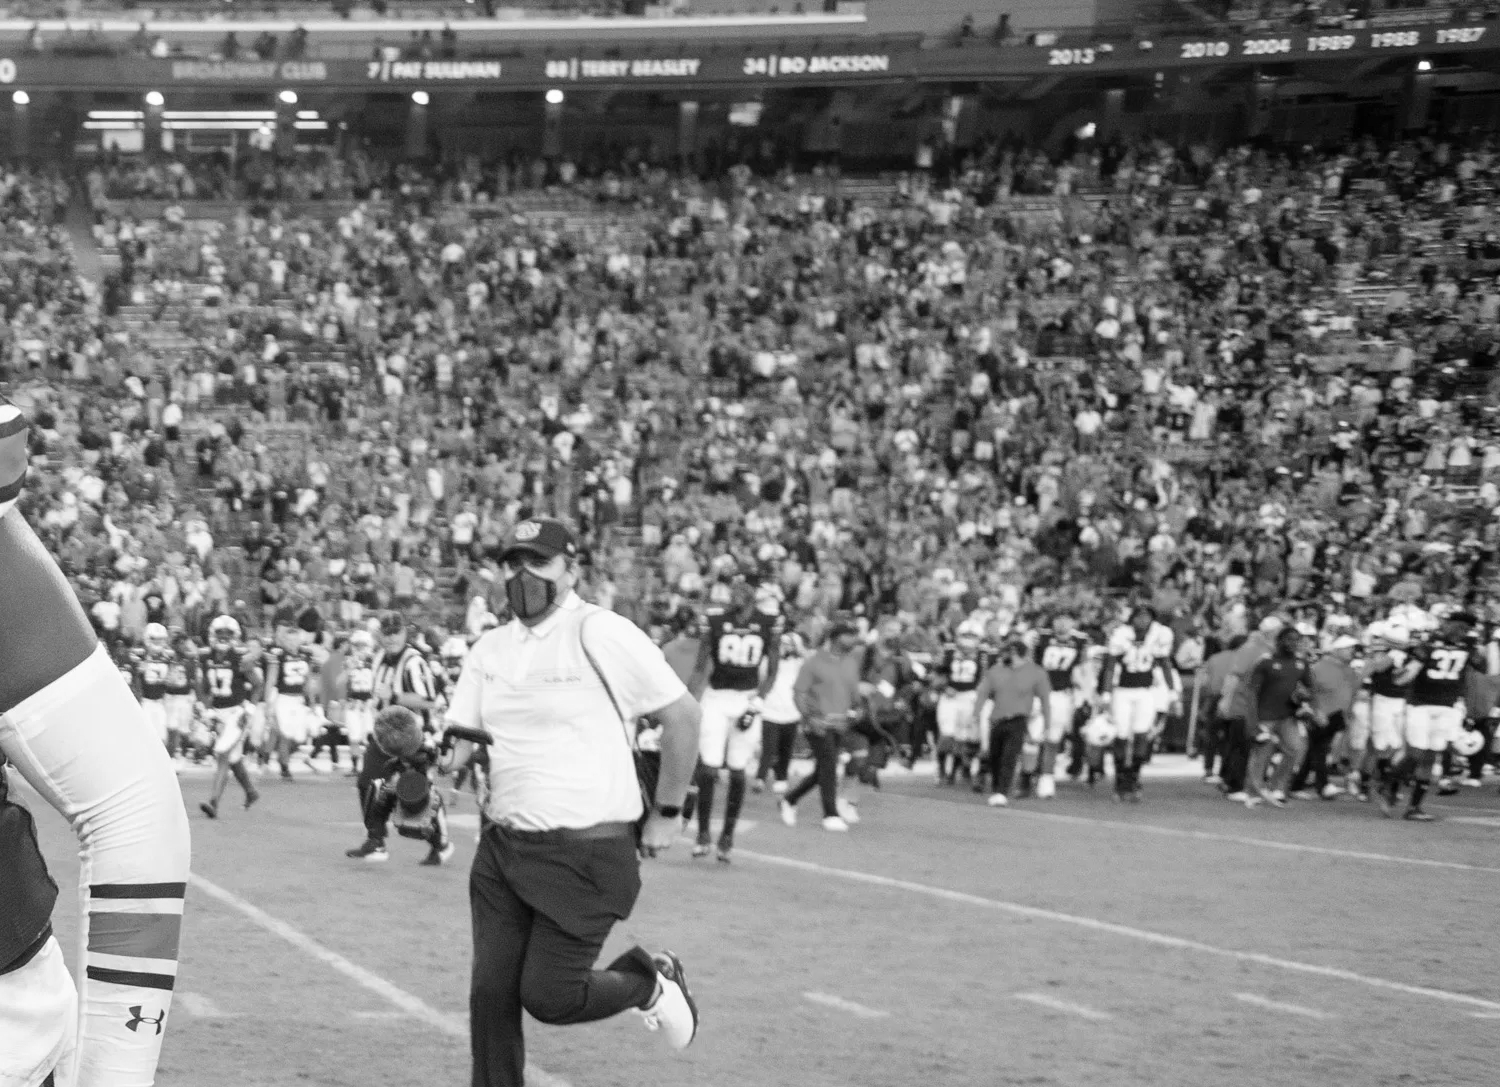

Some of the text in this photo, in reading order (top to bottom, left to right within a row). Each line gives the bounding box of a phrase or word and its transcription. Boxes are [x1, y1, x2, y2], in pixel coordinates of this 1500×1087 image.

[1049, 48, 1094, 65] 2013
[1181, 42, 1229, 58] 2010
[1243, 39, 1291, 55] 2004
[780, 57, 807, 73] BO
[808, 55, 889, 73] JACKSON
[1427, 650, 1469, 680] 37
